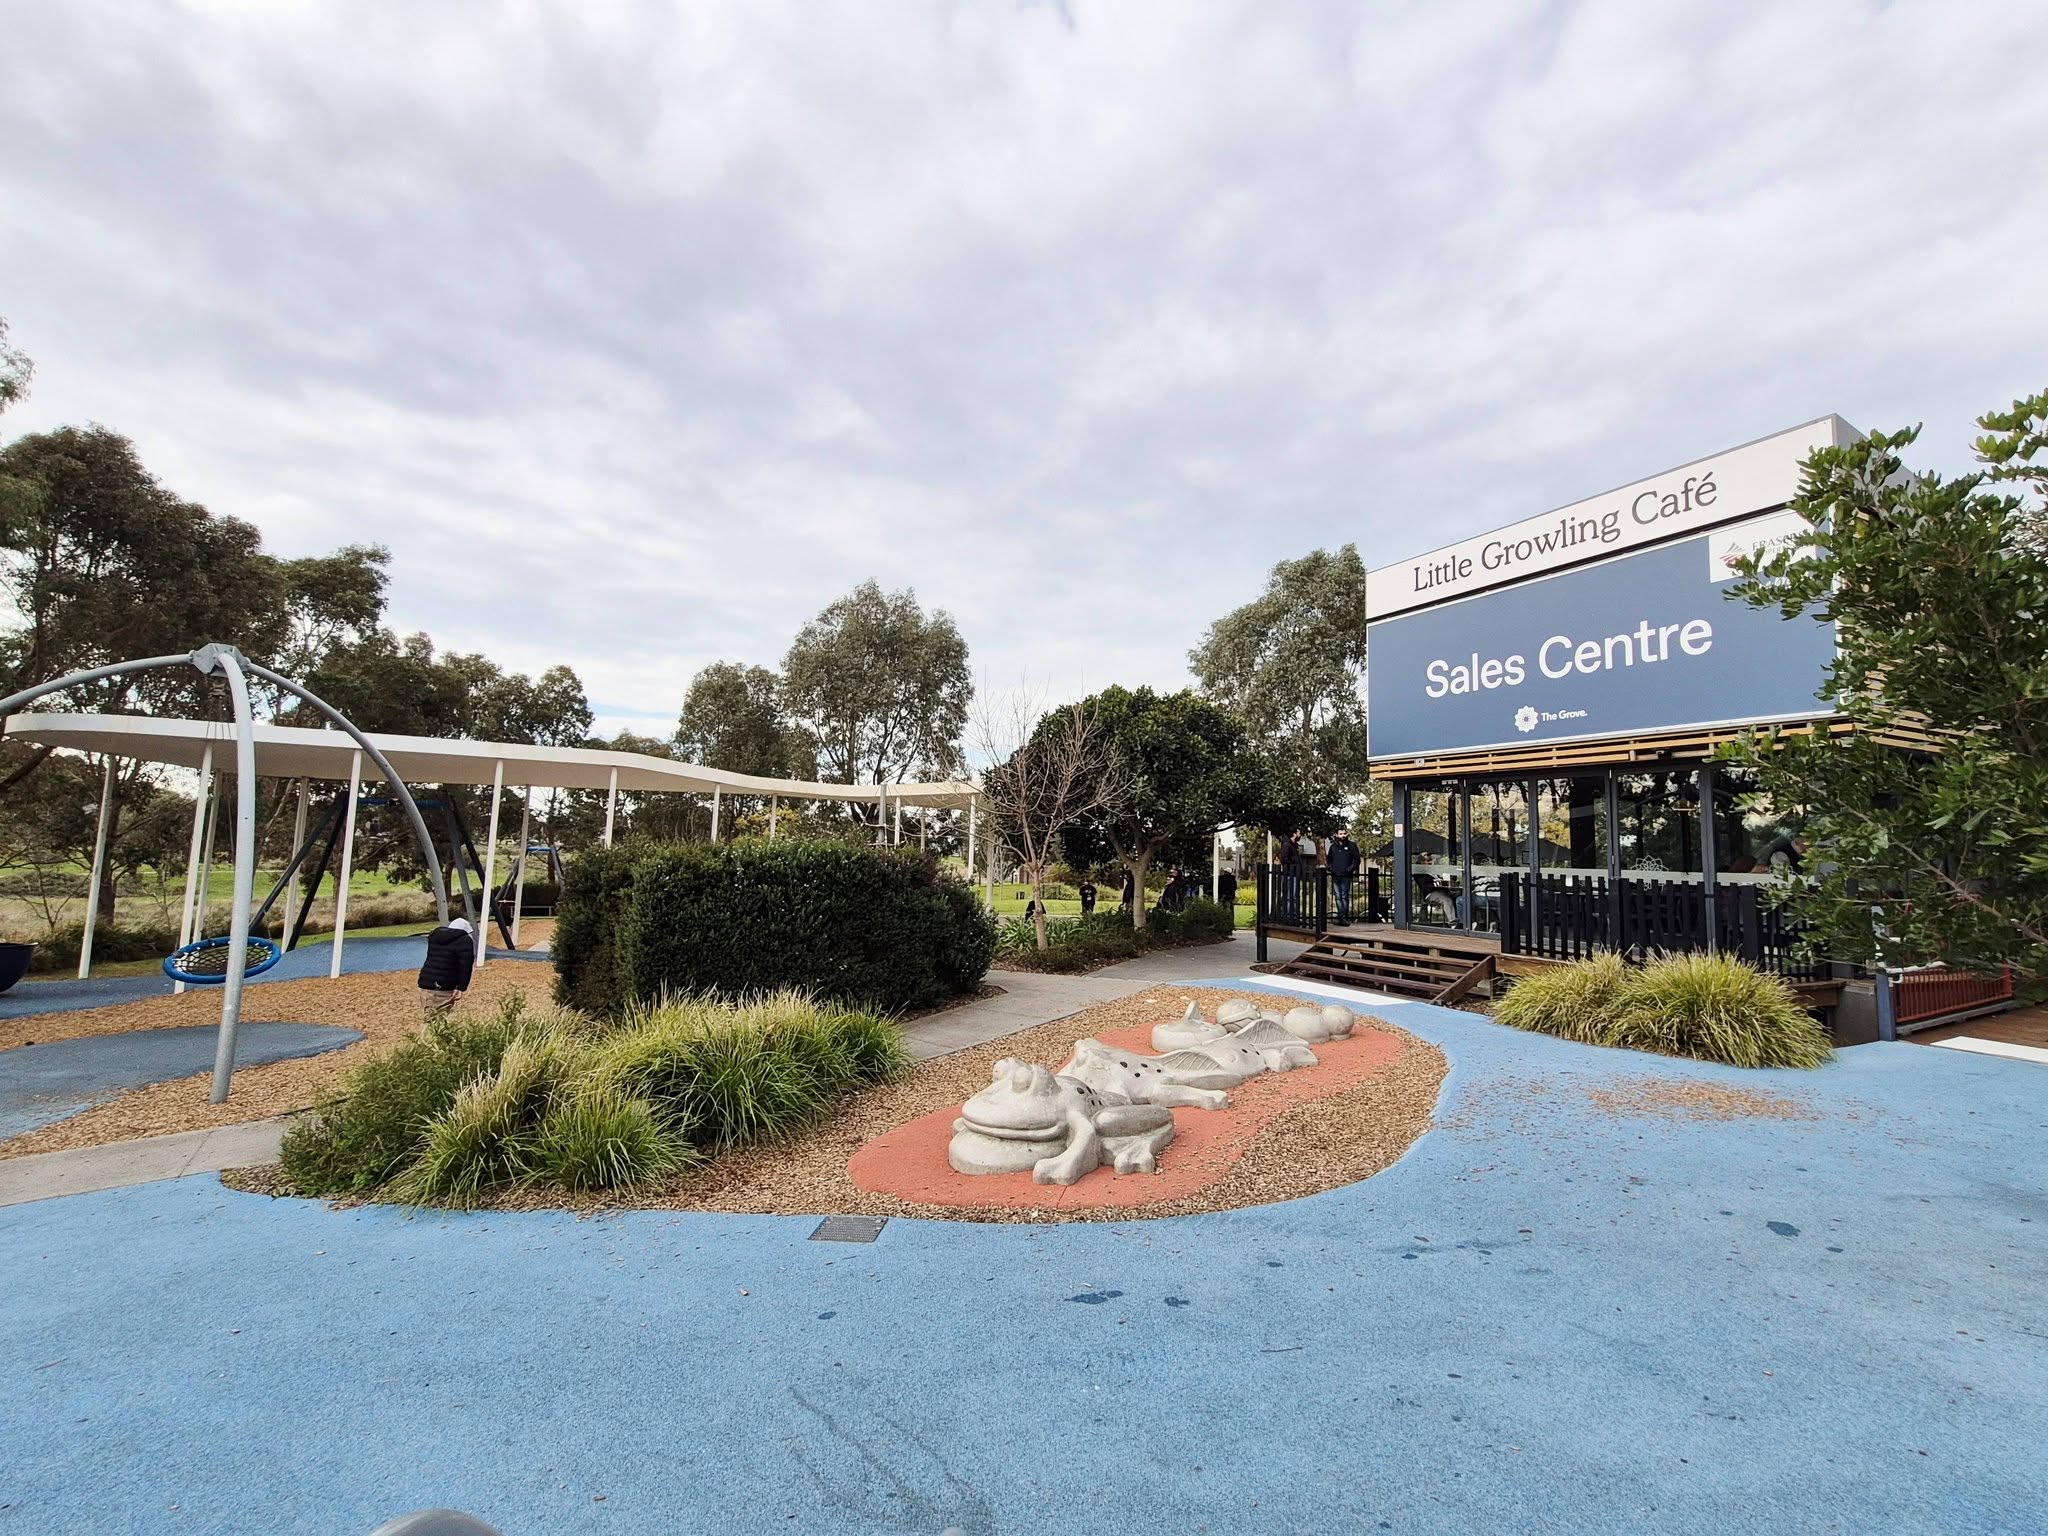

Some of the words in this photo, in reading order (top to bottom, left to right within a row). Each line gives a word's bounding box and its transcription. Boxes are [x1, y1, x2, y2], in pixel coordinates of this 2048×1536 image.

[1414, 555, 1472, 592] Little
[1482, 510, 1621, 571] Growling
[1632, 471, 1718, 525] Café
[1425, 652, 1526, 698] Sales
[1539, 619, 1713, 679] Centre
[1541, 712, 1558, 722] The
[1558, 709, 1588, 720] Grove.
